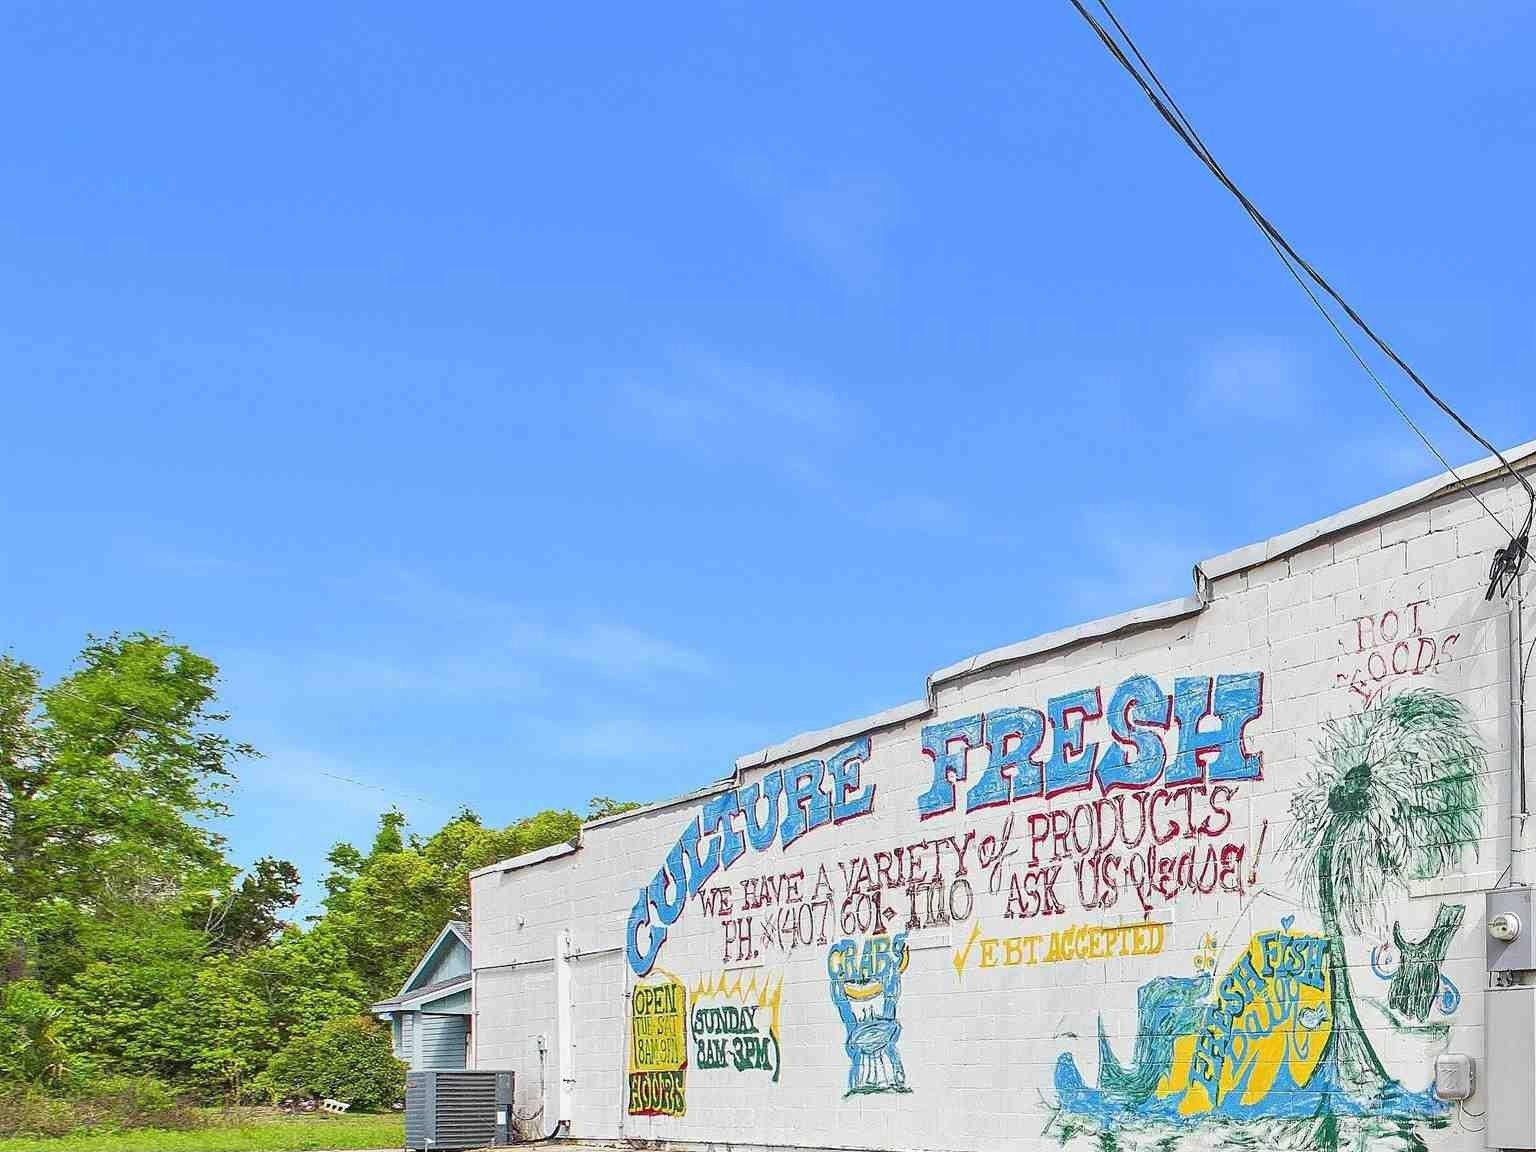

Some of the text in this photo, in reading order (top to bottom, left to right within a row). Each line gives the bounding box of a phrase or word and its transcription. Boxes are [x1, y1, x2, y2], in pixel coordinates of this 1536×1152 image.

[626, 671, 1264, 978] CULTURE FRESH
[700, 886, 733, 917] WE
[741, 870, 804, 911] HAVE
[812, 864, 833, 901] A
[839, 829, 976, 893] VARIETY
[1028, 785, 1239, 867] PRODUCTS
[1004, 865, 1065, 919] ASK
[828, 931, 910, 981] CRABS
[1043, 921, 1165, 964] ACCEPTED
[1257, 931, 1331, 992] FISH
[634, 984, 678, 1015] OPEN
[693, 1005, 760, 1034] SUNDAY
[629, 1071, 686, 1113] HOURS
